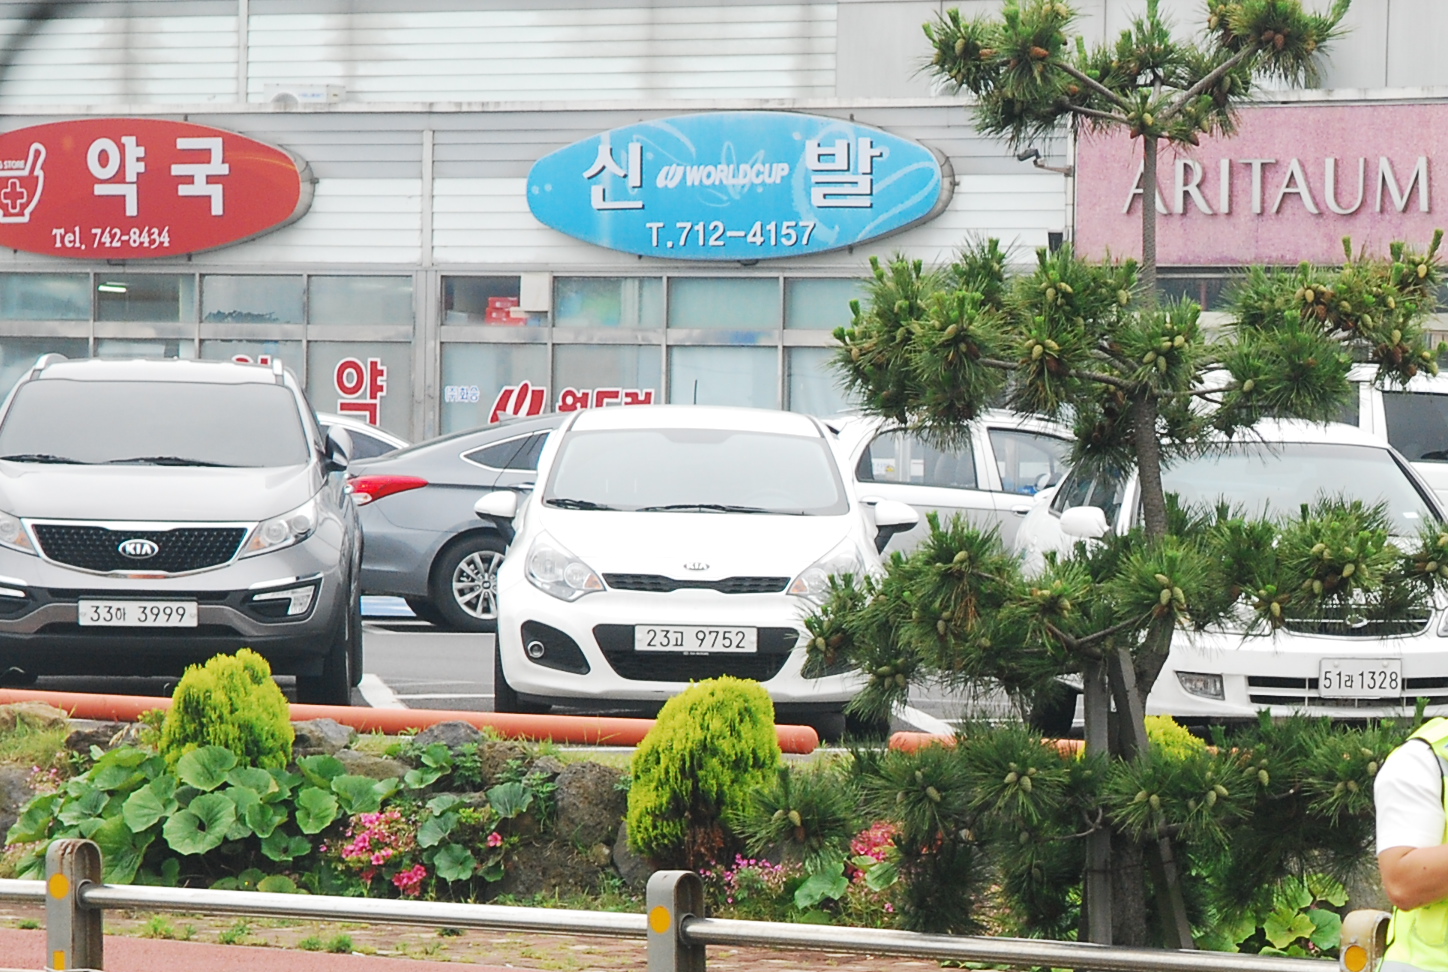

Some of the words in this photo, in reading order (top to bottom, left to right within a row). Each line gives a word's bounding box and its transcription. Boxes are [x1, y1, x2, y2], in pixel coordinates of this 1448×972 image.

[583, 141, 645, 211] 신
[685, 163, 789, 187] WORLDCUP
[804, 136, 882, 208] 발
[1122, 156, 1431, 214] ARITAUM
[91, 226, 170, 248] 742-8434
[646, 220, 816, 248] T.712-4157
[126, 544, 151, 554] KIA
[686, 562, 707, 571] KIA
[91, 606, 126, 622] 33하
[138, 606, 186, 622] 3999
[647, 629, 684, 647] 23고
[695, 630, 746, 648] 9752
[1324, 671, 1353, 689] 51라
[1359, 671, 1398, 689] 1328
